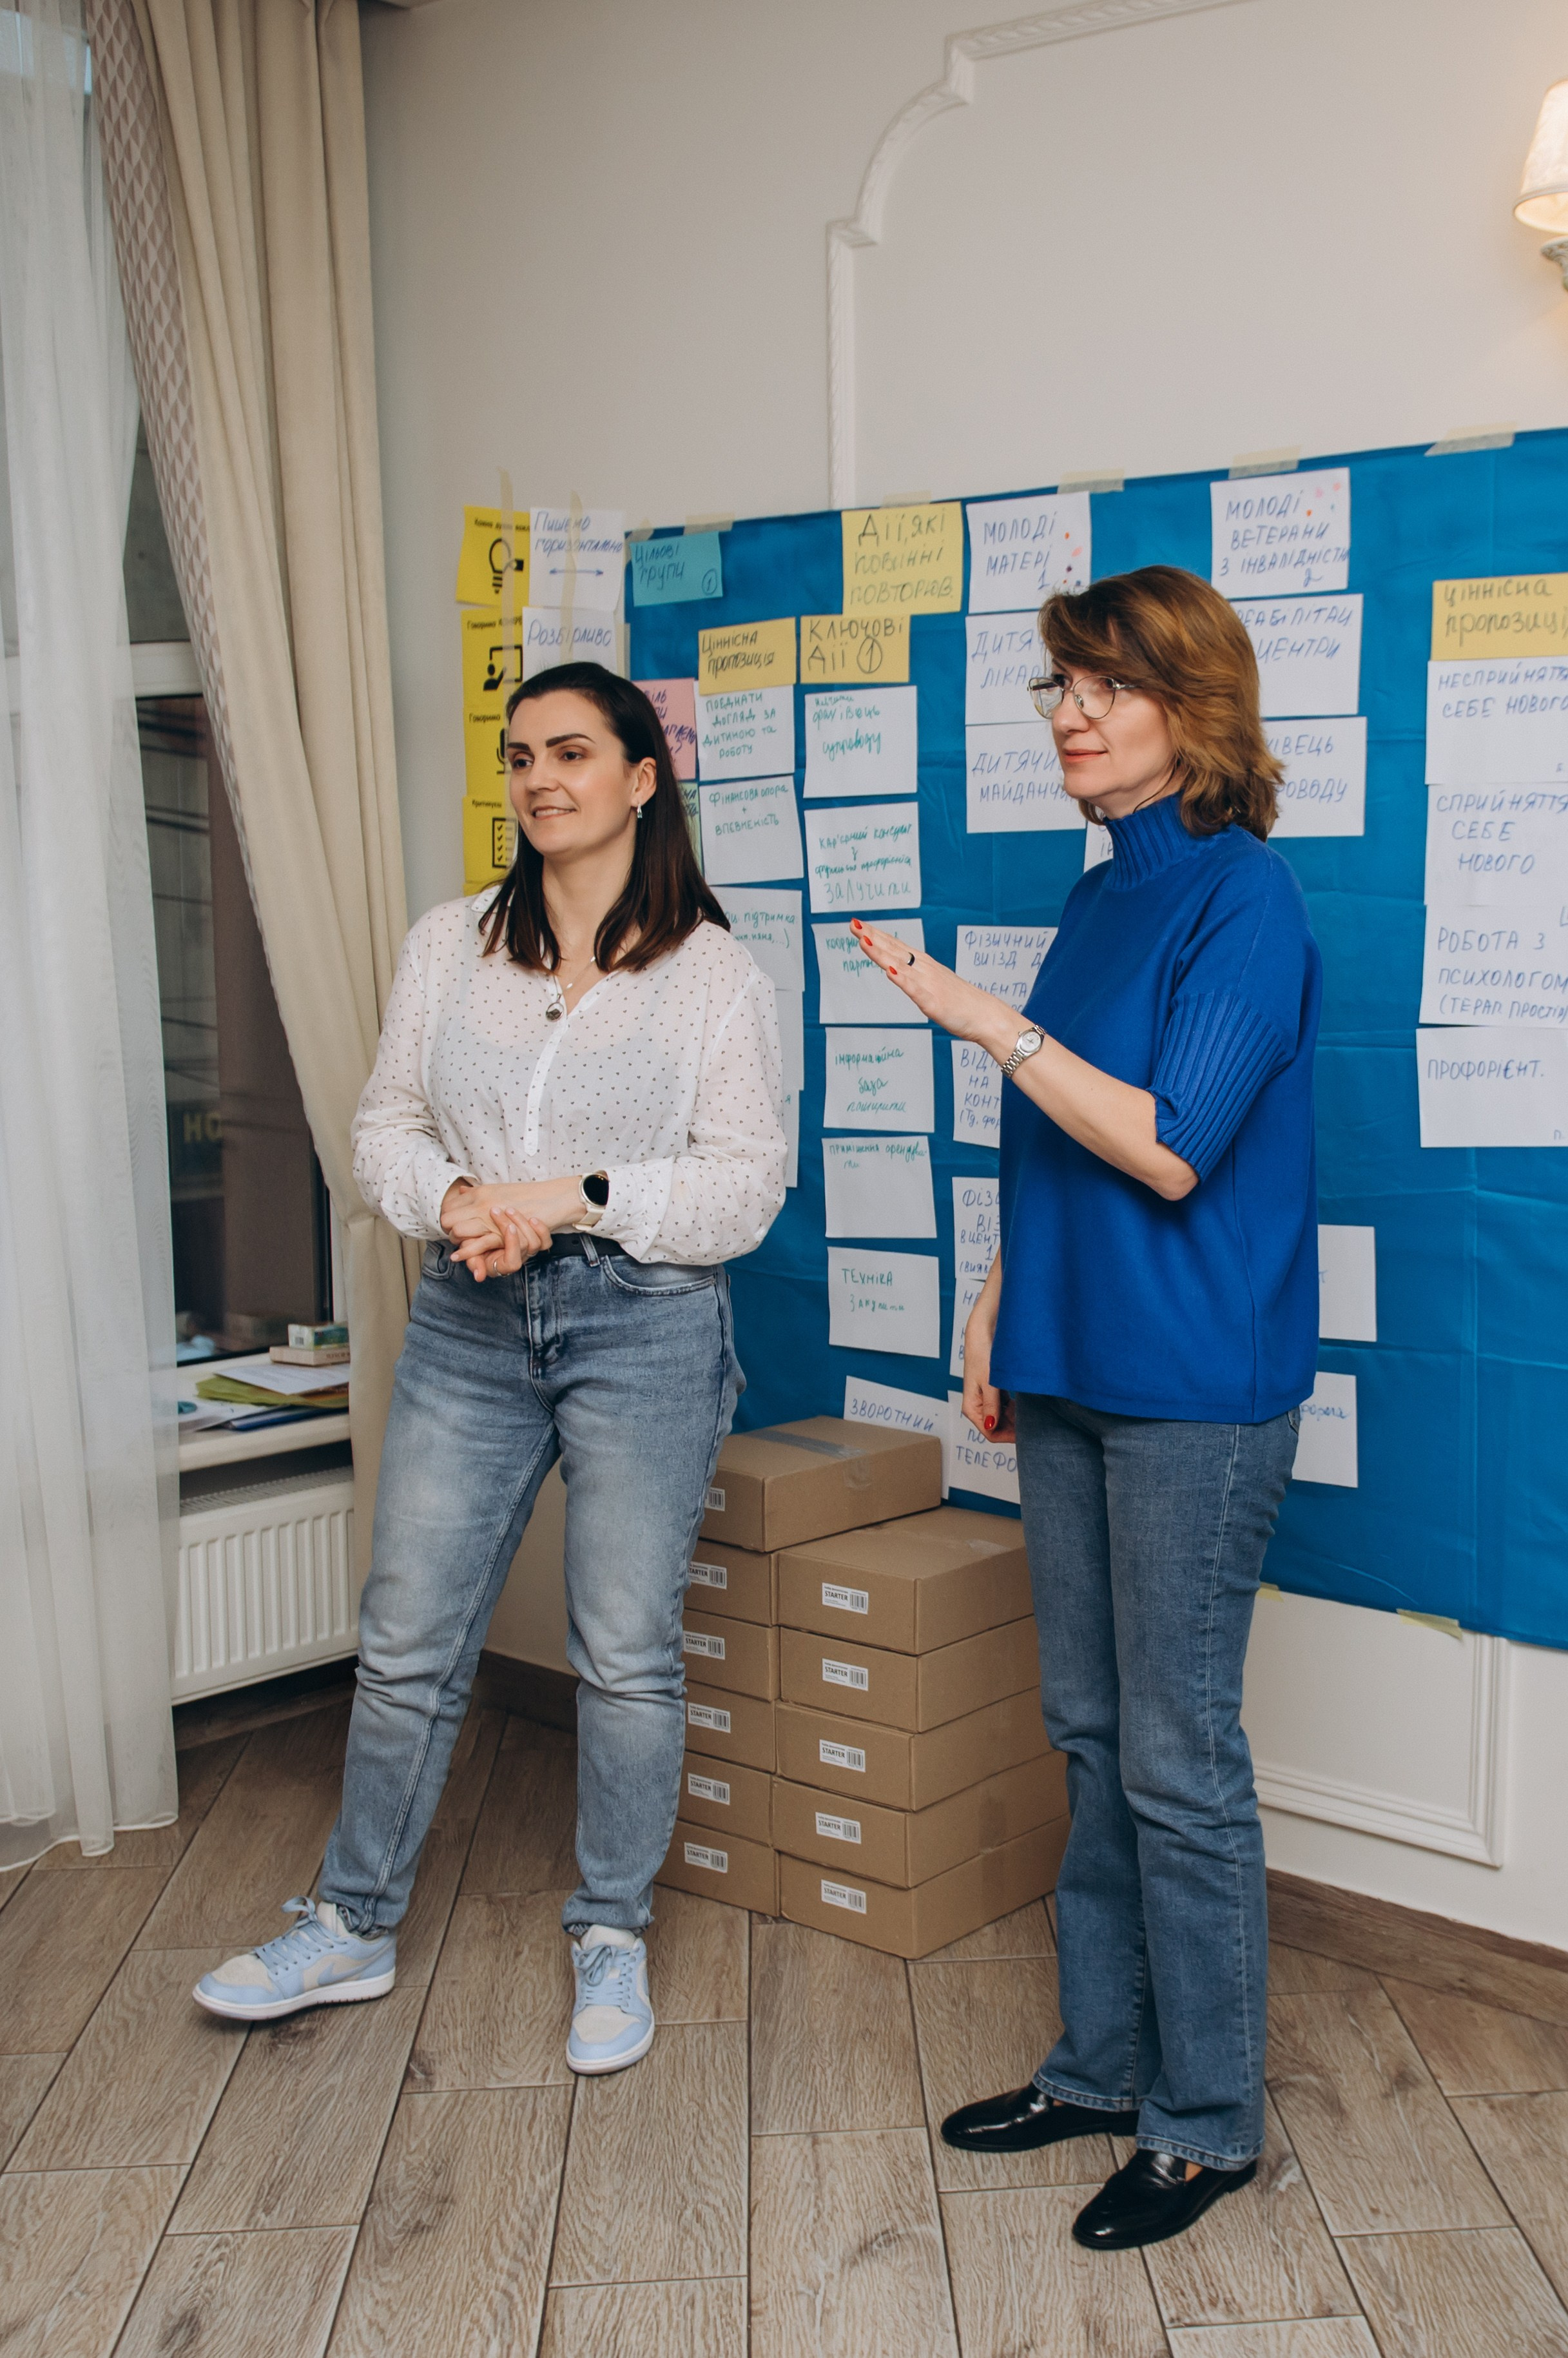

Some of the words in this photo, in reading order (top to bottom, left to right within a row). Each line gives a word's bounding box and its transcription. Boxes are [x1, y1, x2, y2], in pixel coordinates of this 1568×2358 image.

[971, 749, 1063, 778] ДИТЯЧИ
[1451, 820, 1515, 841] СЕБЕ
[1458, 852, 1534, 875] НОВОГО
[1437, 926, 1518, 953] РОБОТА
[825, 1590, 848, 1601] STARTER
[685, 1637, 707, 1648] STARTER
[825, 1666, 848, 1677] STARTER
[690, 1710, 711, 1720] STARTER
[822, 1747, 845, 1758] STARTER
[690, 1780, 711, 1792] STARTER
[818, 1818, 841, 1831] STARTER
[686, 1849, 709, 1860] STARTER
[824, 1886, 846, 1900] STARTER
